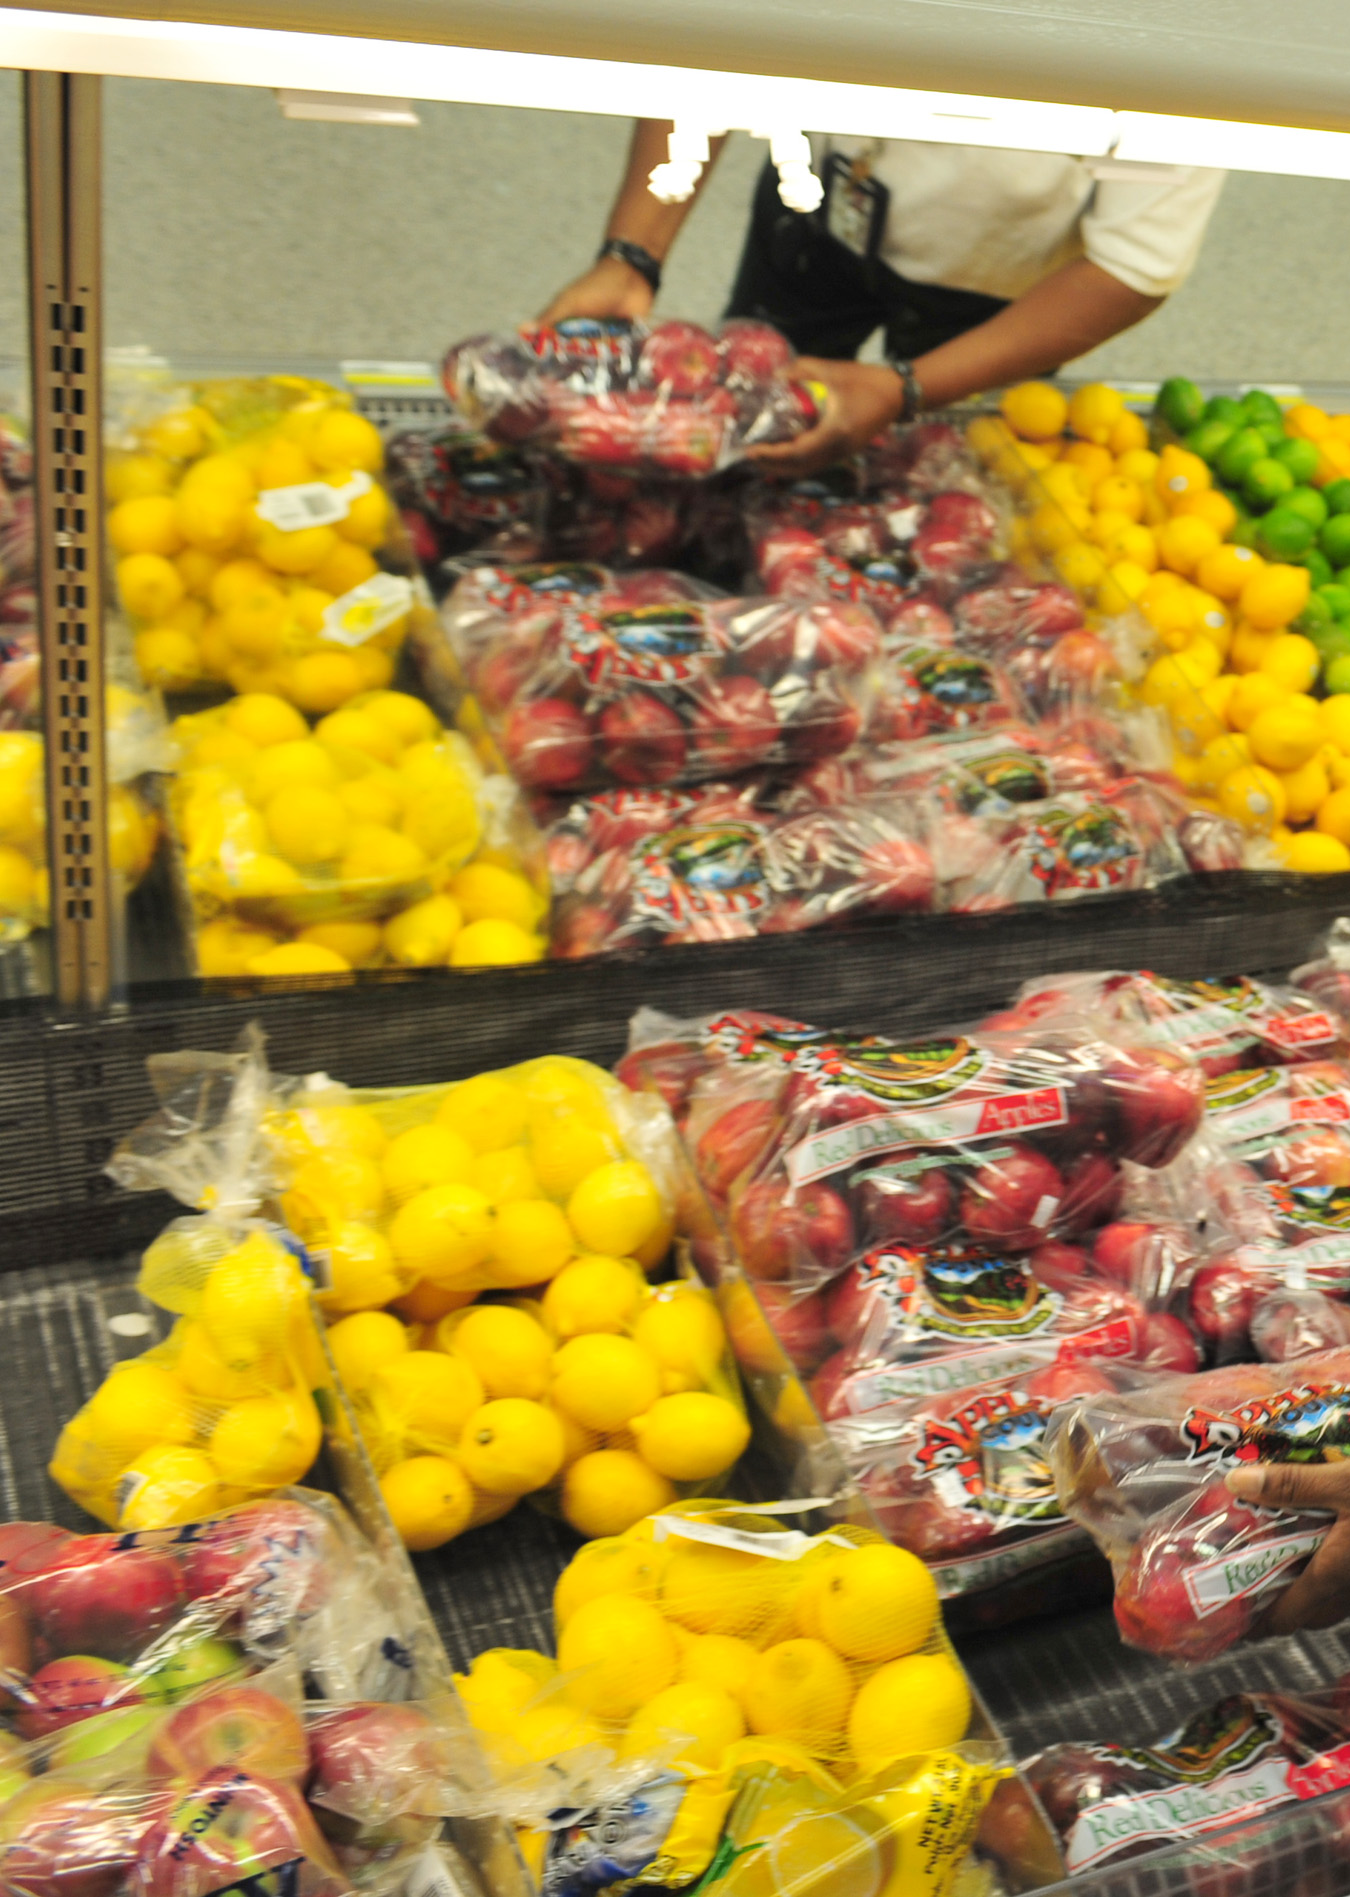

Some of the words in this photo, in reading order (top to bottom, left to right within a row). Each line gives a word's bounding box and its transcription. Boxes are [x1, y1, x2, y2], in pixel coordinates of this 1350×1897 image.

[981, 1094, 1058, 1129] Apples
[916, 1391, 1056, 1466] APPL
[1087, 1810, 1145, 1847] Red
[1147, 1781, 1267, 1829] Delicious
